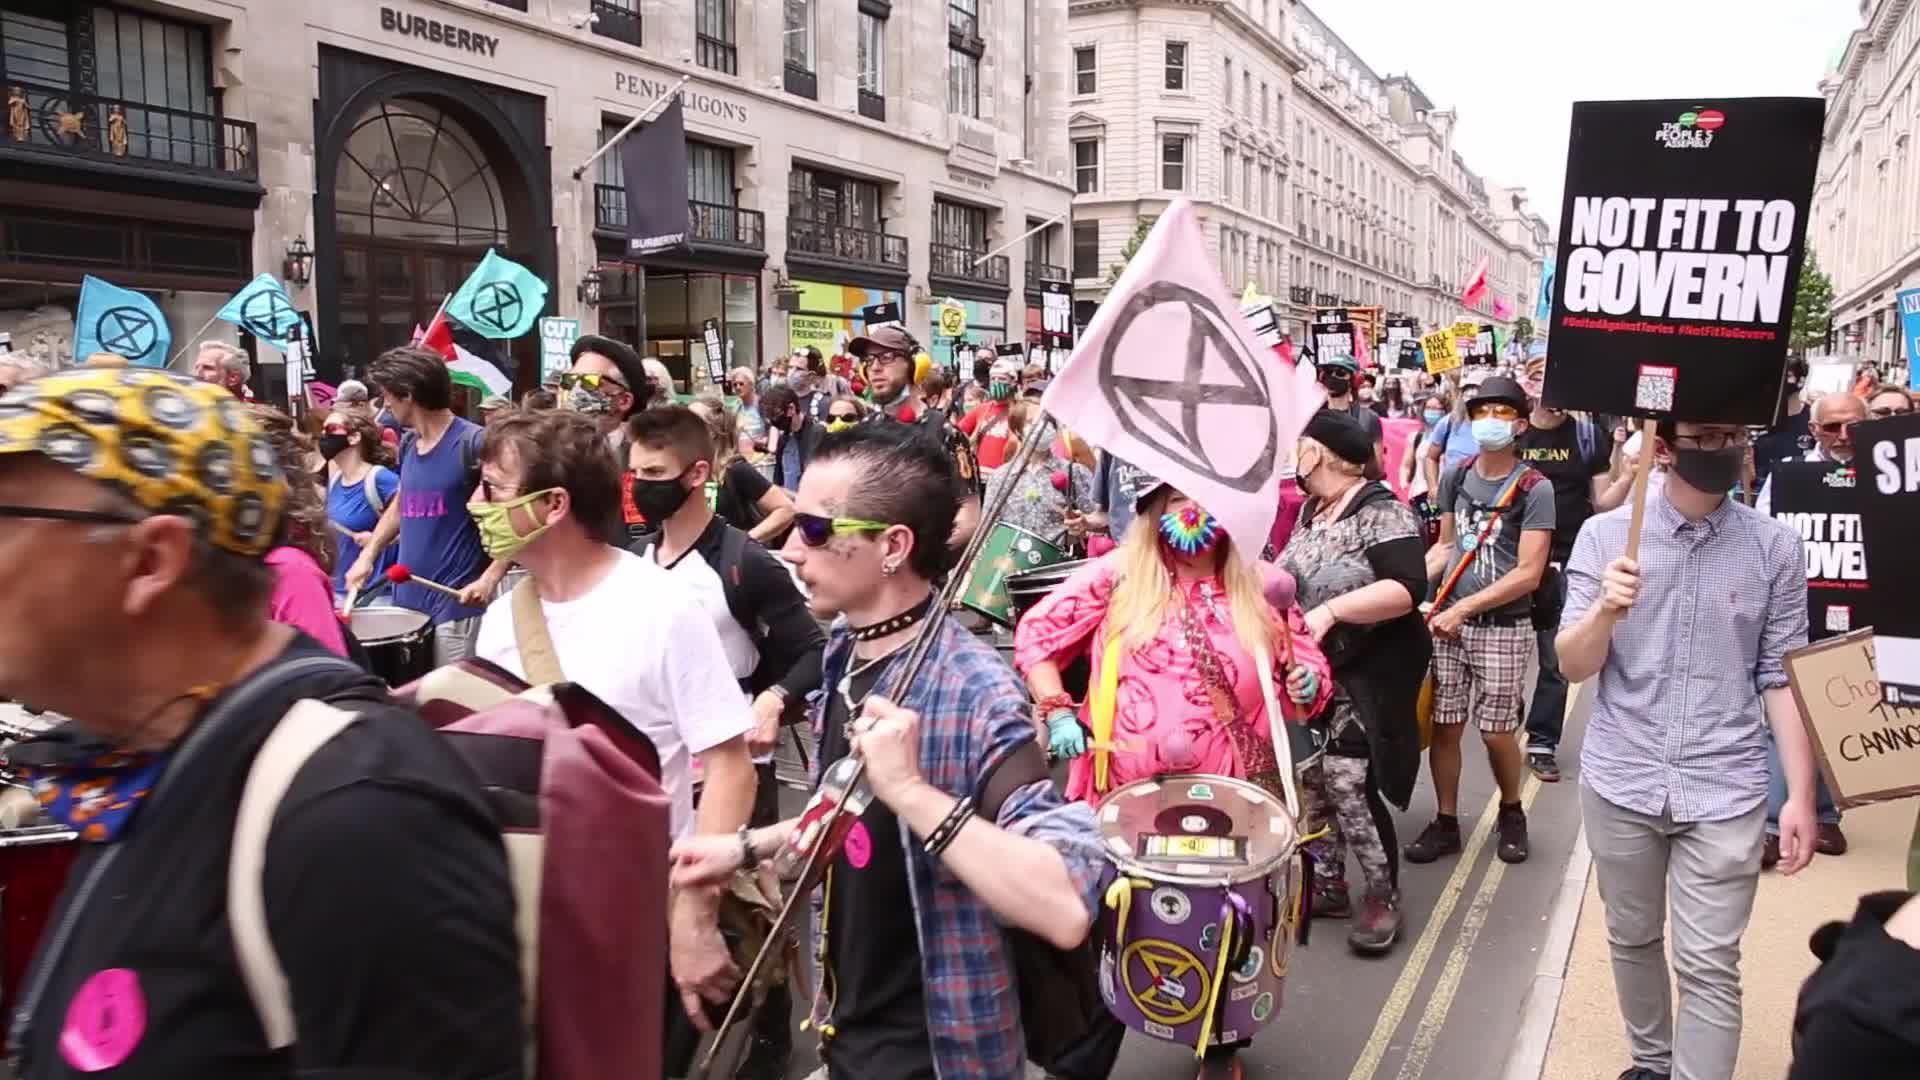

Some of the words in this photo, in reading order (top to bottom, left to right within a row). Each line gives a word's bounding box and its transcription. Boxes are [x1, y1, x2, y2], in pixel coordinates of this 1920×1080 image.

[381, 7, 499, 57] BURBERRY
[1661, 123, 1681, 131] THE
[1664, 140, 1711, 148] ASSEMBLY
[1571, 196, 1656, 248] NOT
[1657, 198, 1729, 250] FIT
[1735, 199, 1796, 253] TO
[631, 233, 683, 249] BURBERRY
[1564, 247, 1789, 324] GOVERN
[544, 320, 576, 338] CUT
[1043, 308, 1070, 334] OUT
[1425, 333, 1449, 345] KILL
[1426, 342, 1449, 352] THE
[1428, 349, 1454, 361] BILL
